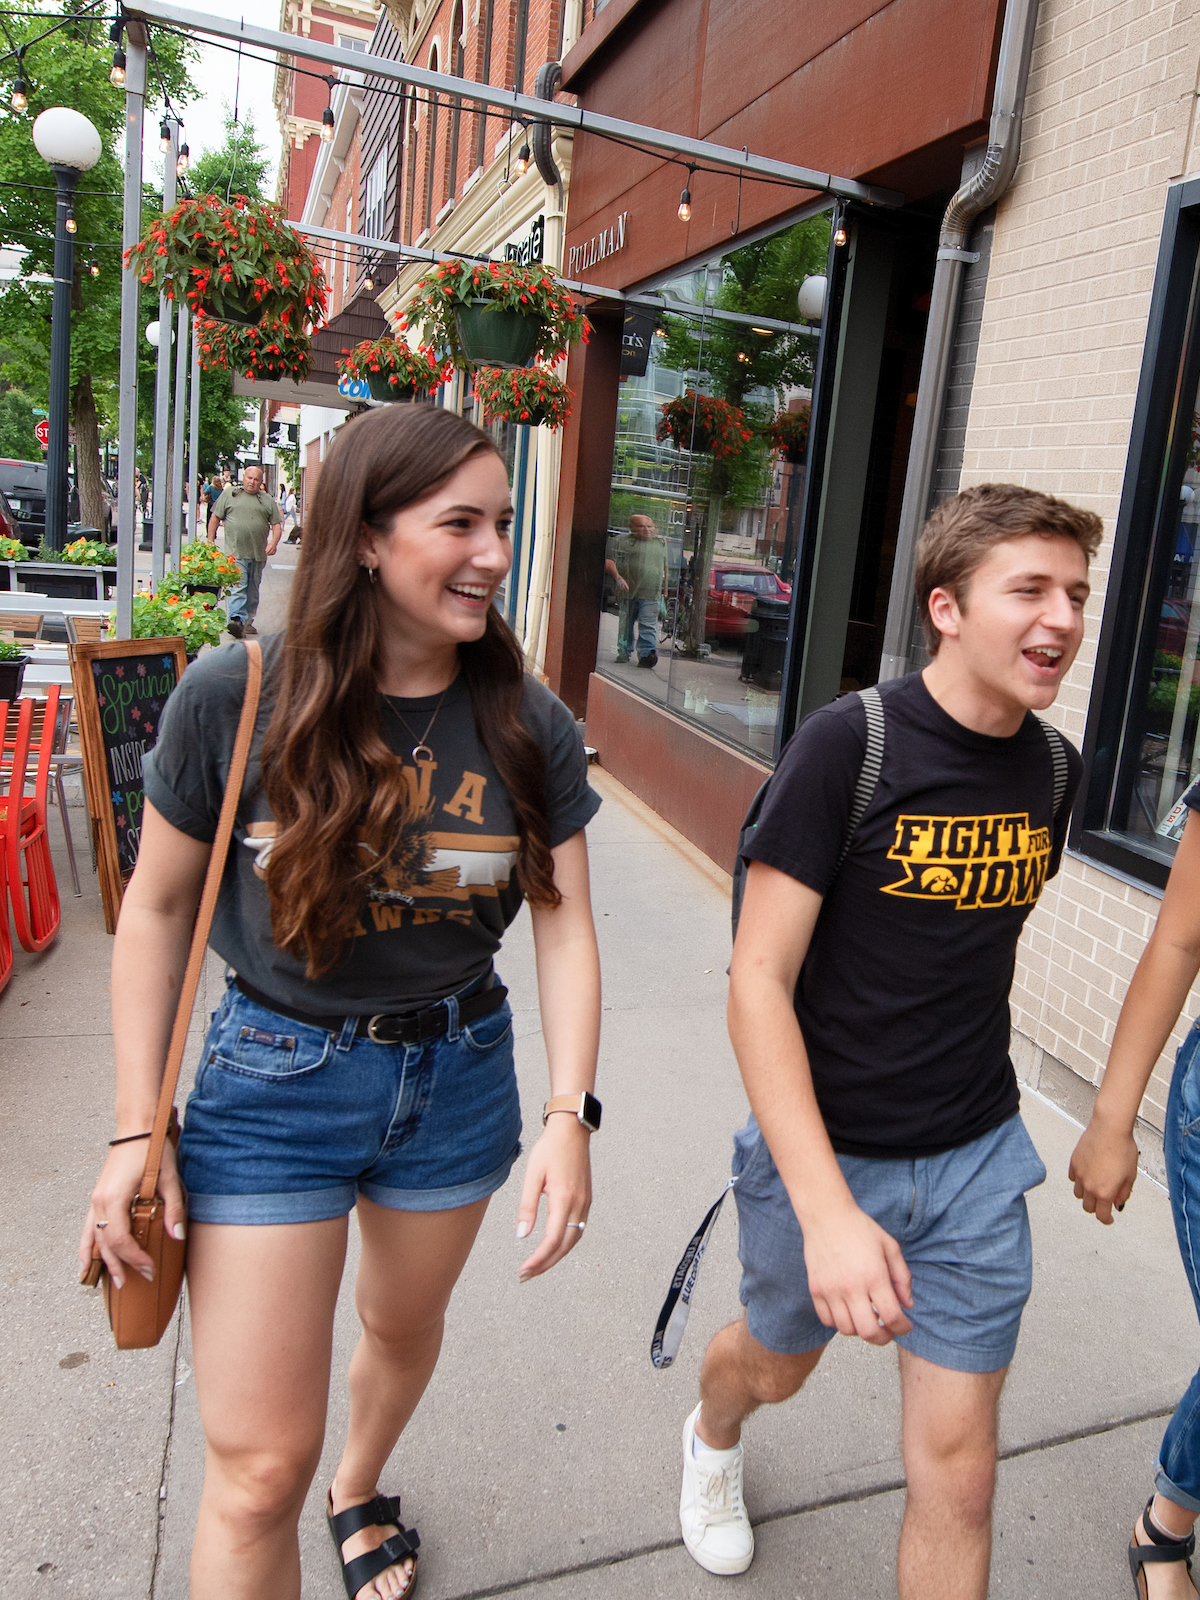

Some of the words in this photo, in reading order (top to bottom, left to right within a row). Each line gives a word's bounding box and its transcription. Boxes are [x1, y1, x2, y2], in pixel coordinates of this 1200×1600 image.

[568, 210, 628, 279] PULLMAN
[37, 427, 50, 438] ST
[890, 815, 1028, 860] FIGHT
[1027, 829, 1051, 851] FOR
[957, 857, 1048, 909] IOW
